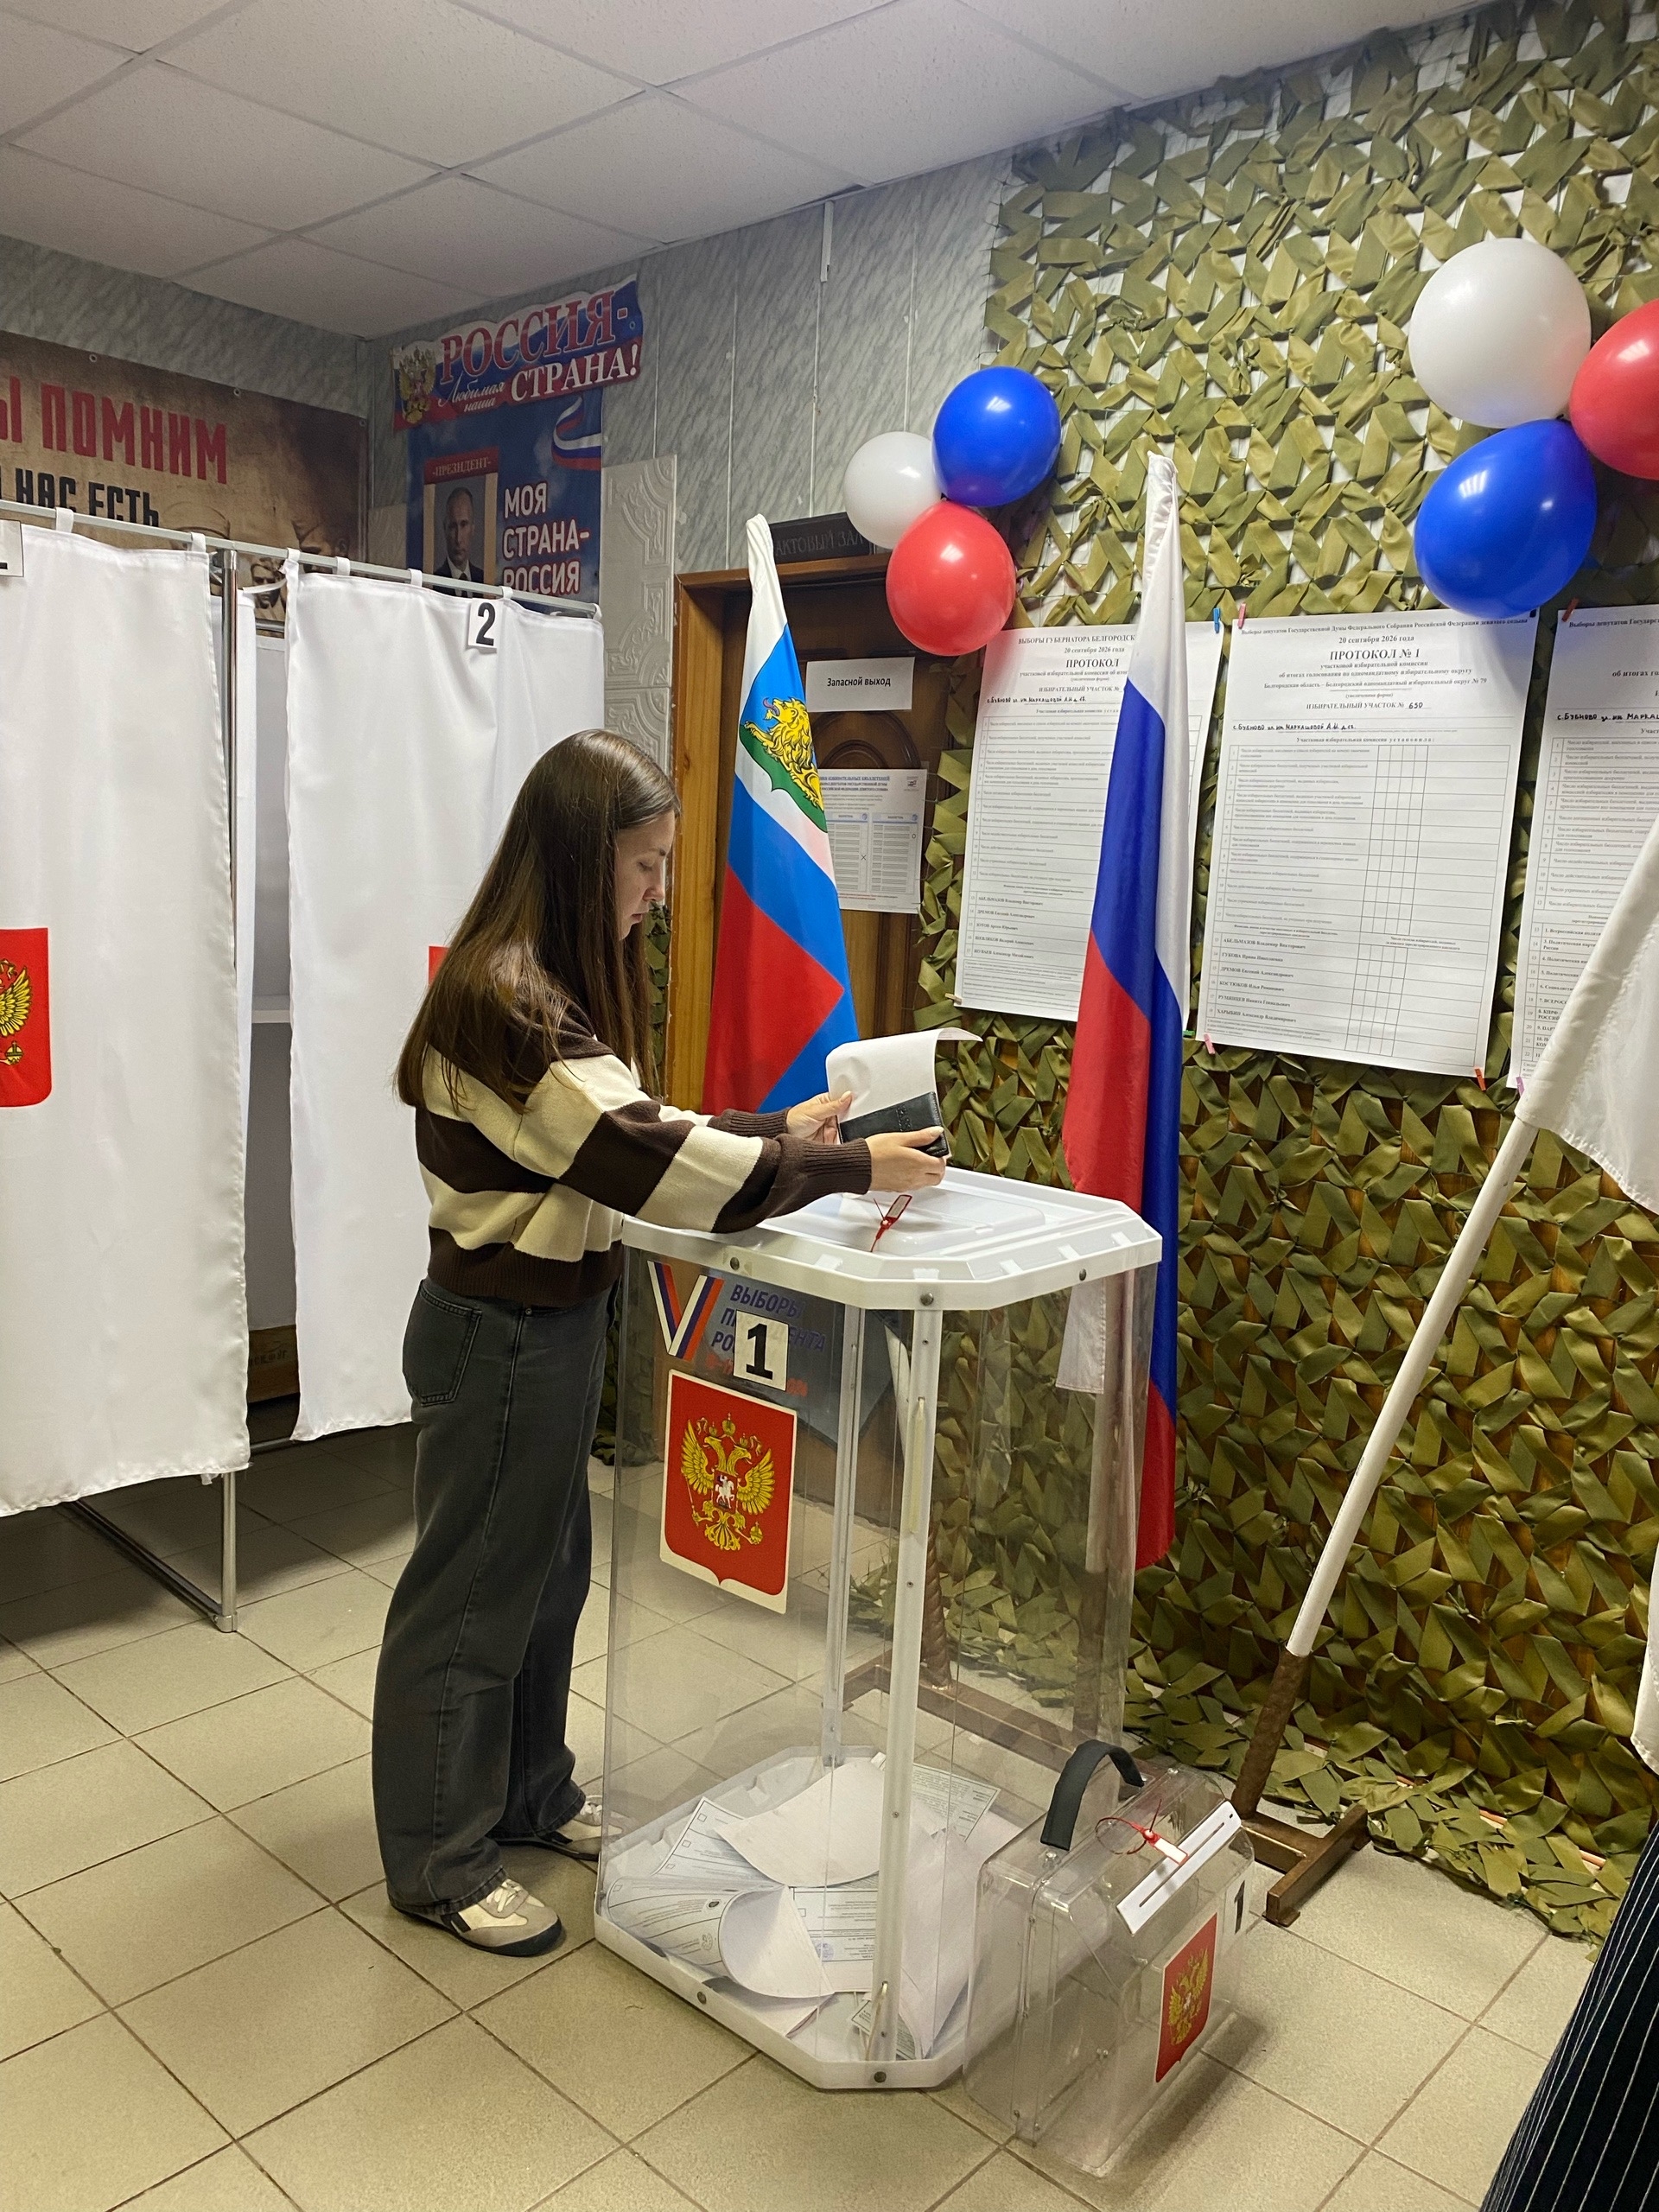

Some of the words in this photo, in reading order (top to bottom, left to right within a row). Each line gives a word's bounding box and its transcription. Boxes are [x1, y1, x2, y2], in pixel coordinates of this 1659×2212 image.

[438, 371, 505, 407] Любимая
[511, 343, 639, 402] СТРАНА!
[463, 397, 495, 412] наша
[41, 382, 227, 485] ПОМНИМ
[16, 467, 76, 512] НАС
[88, 481, 160, 527] ЕСТЬ
[504, 482, 547, 518] МОЯ
[838, 530, 863, 547] ЗАЛ
[503, 561, 580, 594] РОССИЯ
[476, 601, 496, 645] 2
[1066, 658, 1120, 668] ПРОТОКОЛ
[1330, 649, 1396, 661] ПРОТОКОЛ
[1400, 648, 1412, 658] №
[1414, 648, 1420, 658] 1
[1354, 660, 1398, 669] избирательной
[827, 677, 863, 686] Запасной
[864, 677, 891, 687] выход
[746, 1323, 773, 1380] 1
[1234, 1879, 1245, 1935] 1
